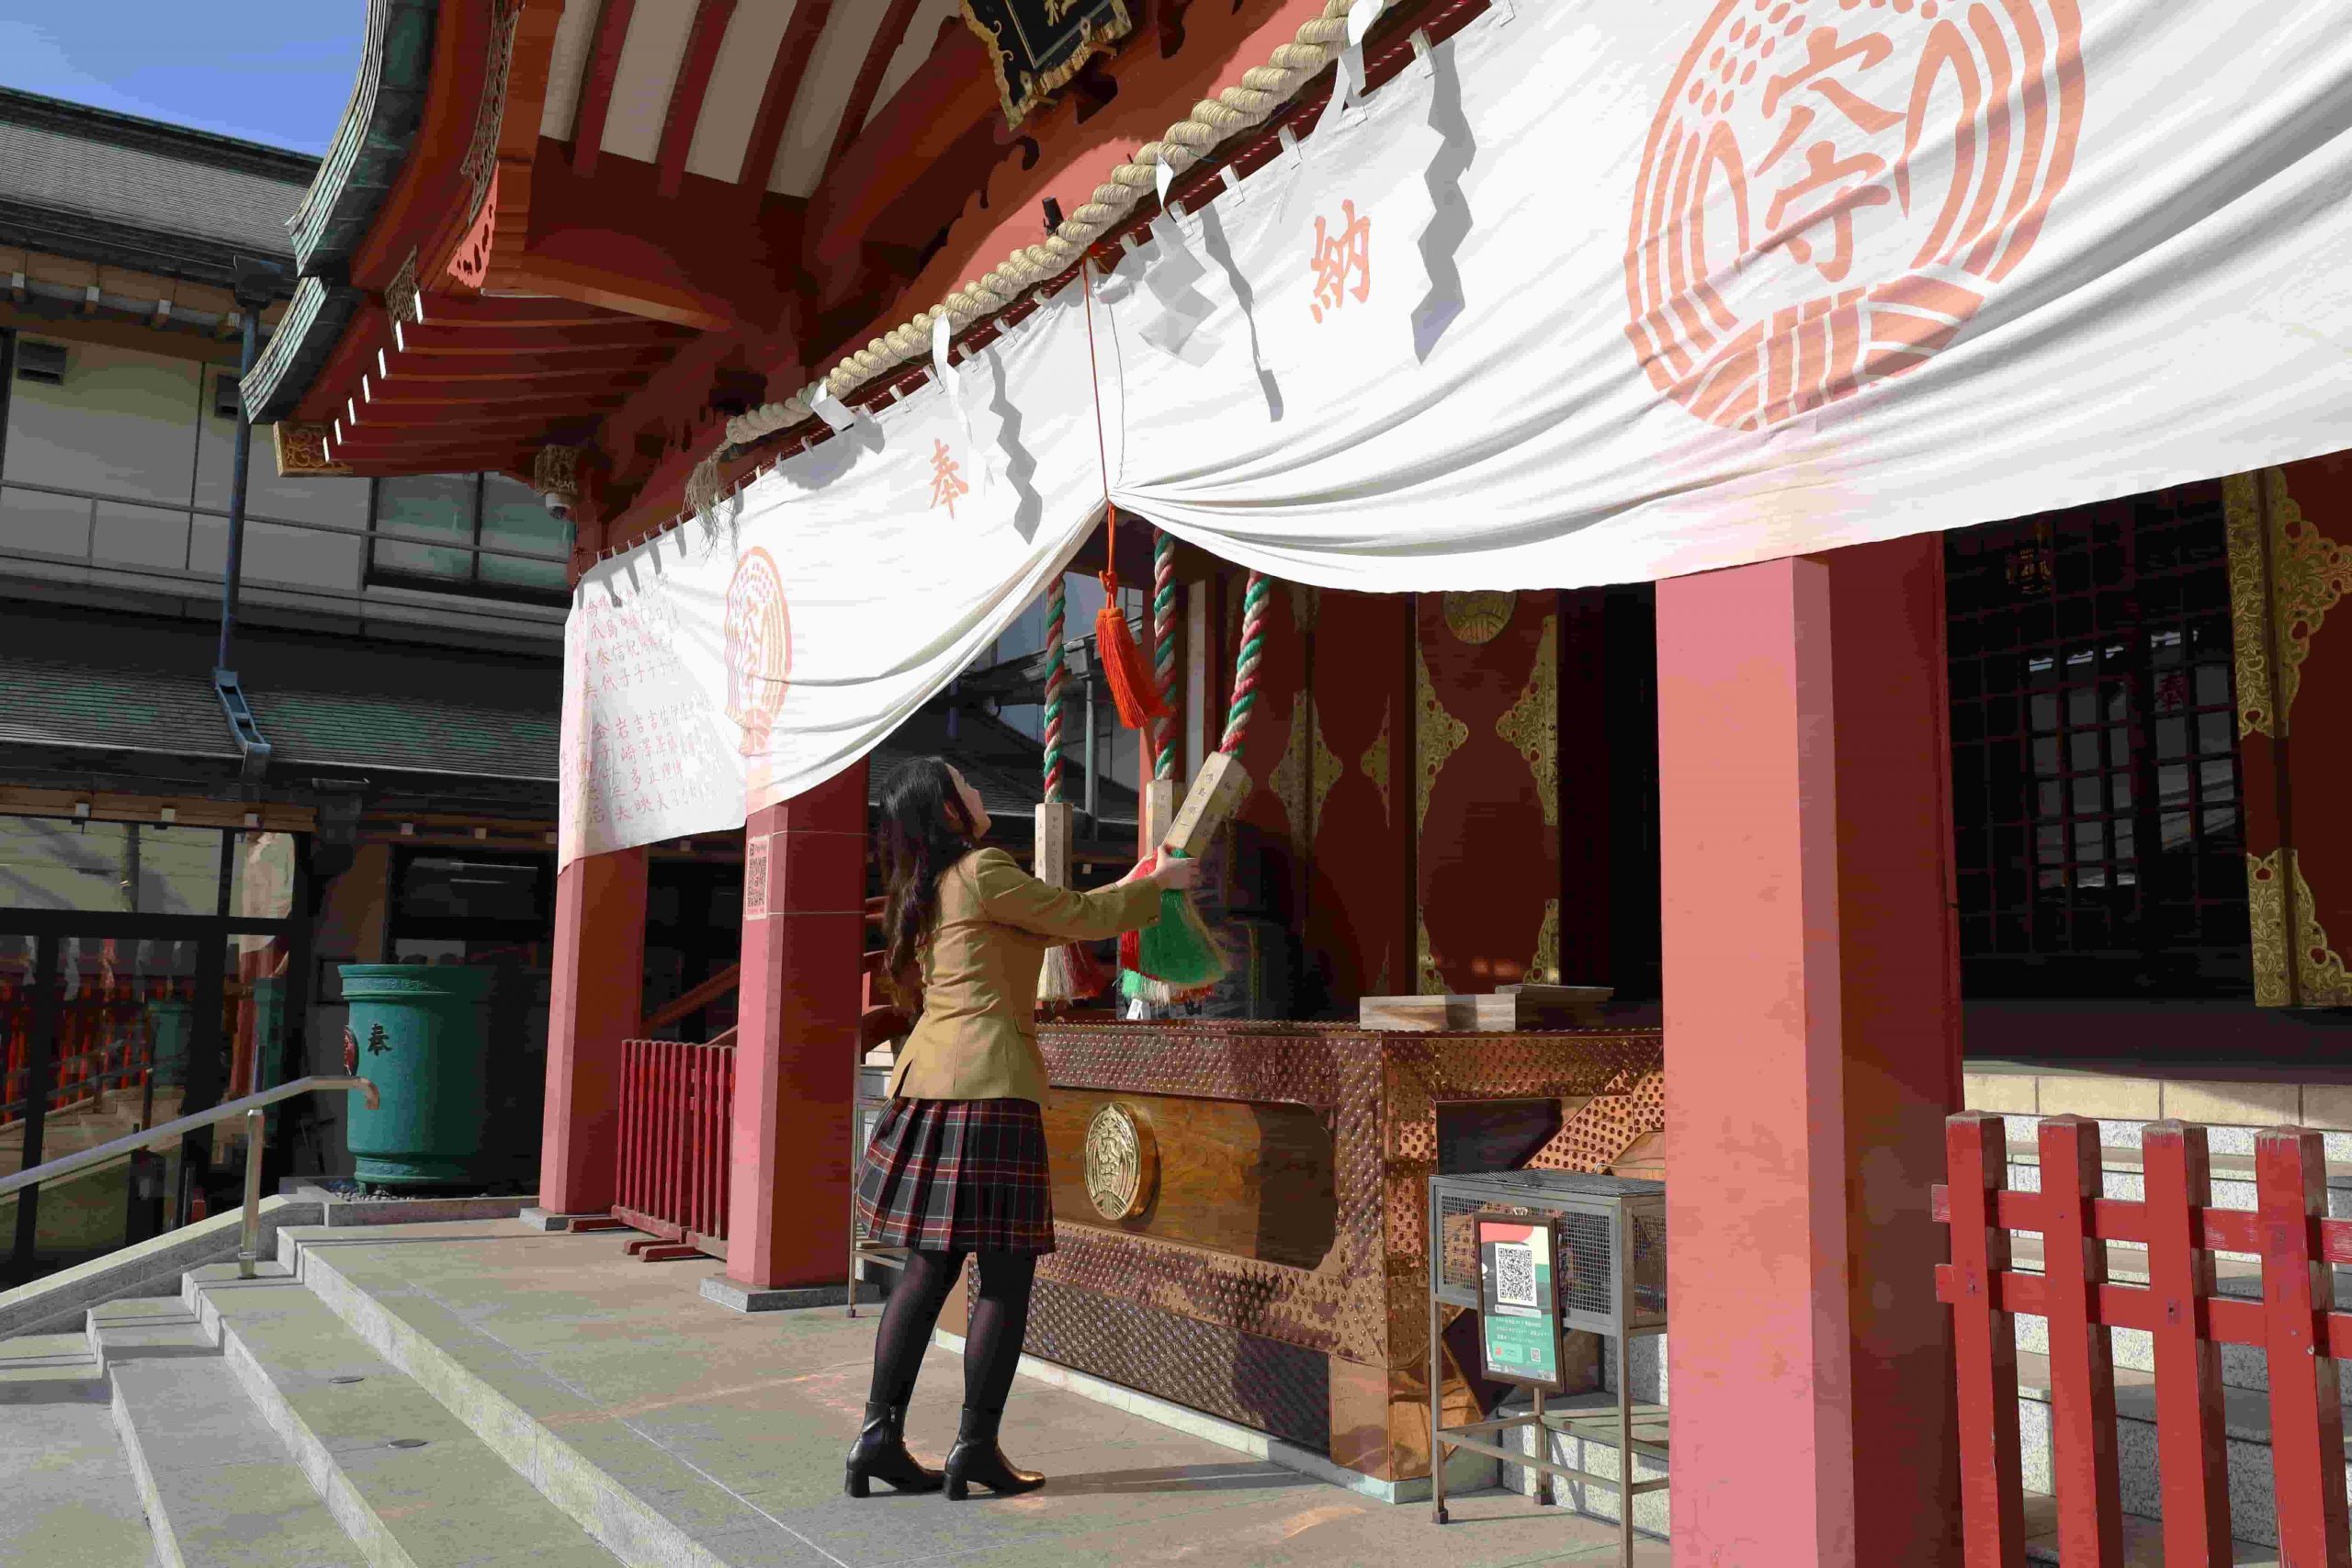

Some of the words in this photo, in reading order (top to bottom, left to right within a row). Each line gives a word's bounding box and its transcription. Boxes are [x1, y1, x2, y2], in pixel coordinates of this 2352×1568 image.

[930, 438, 968, 521] 奉
[1310, 198, 1371, 324] 納
[367, 1022, 392, 1056] 奉
